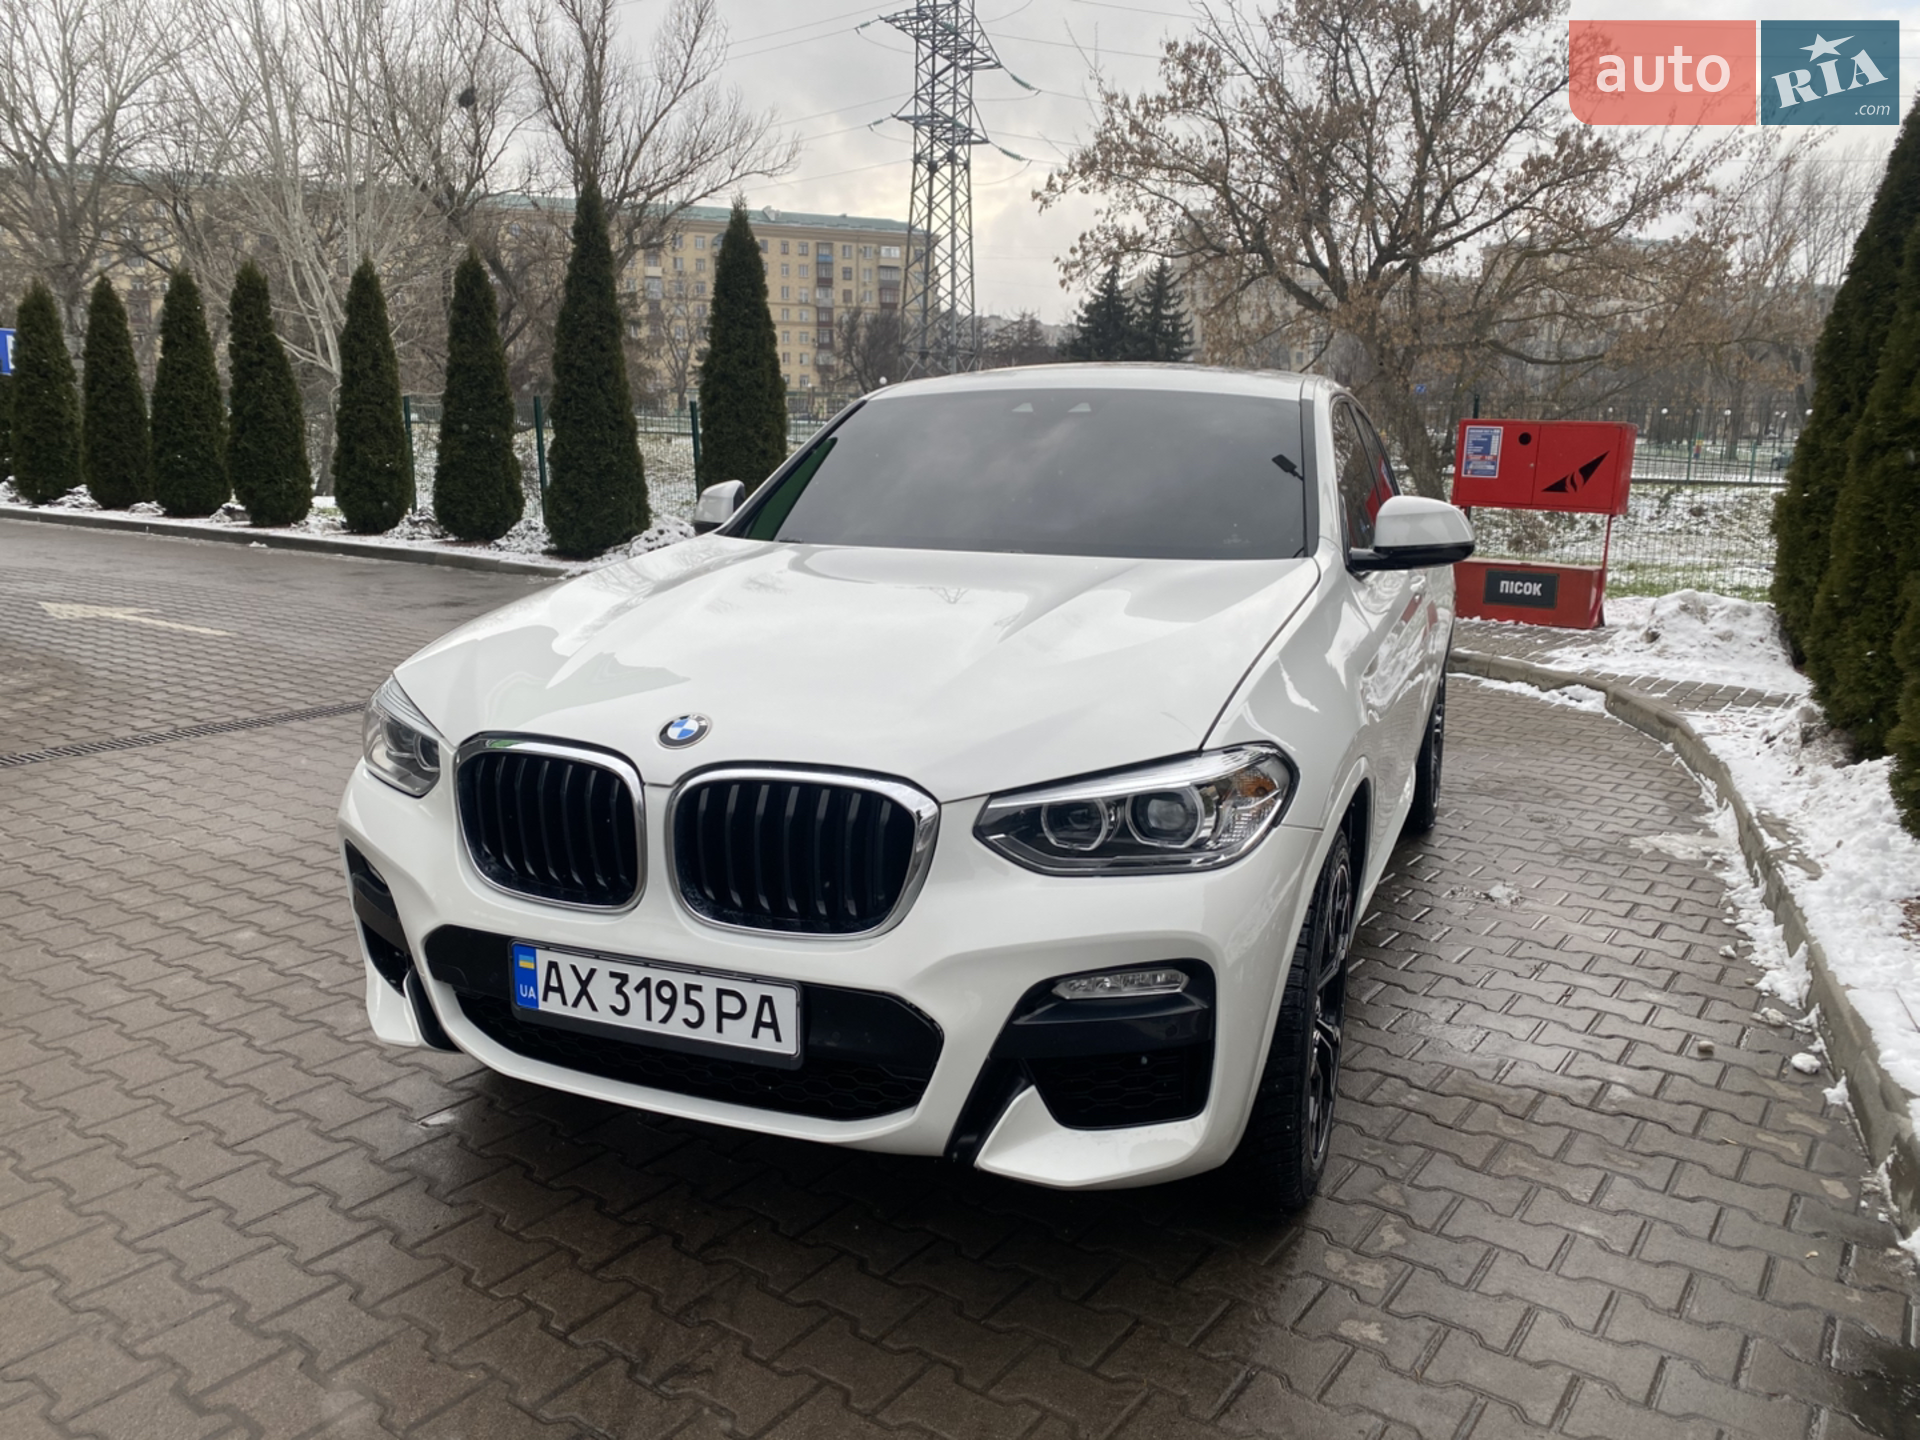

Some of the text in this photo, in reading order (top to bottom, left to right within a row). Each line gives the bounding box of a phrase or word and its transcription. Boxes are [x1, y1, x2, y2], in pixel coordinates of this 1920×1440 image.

[1500, 580, 1542, 596] ПІСОК
[519, 984, 537, 999] UA
[541, 960, 783, 1043] AX 3195 PA
